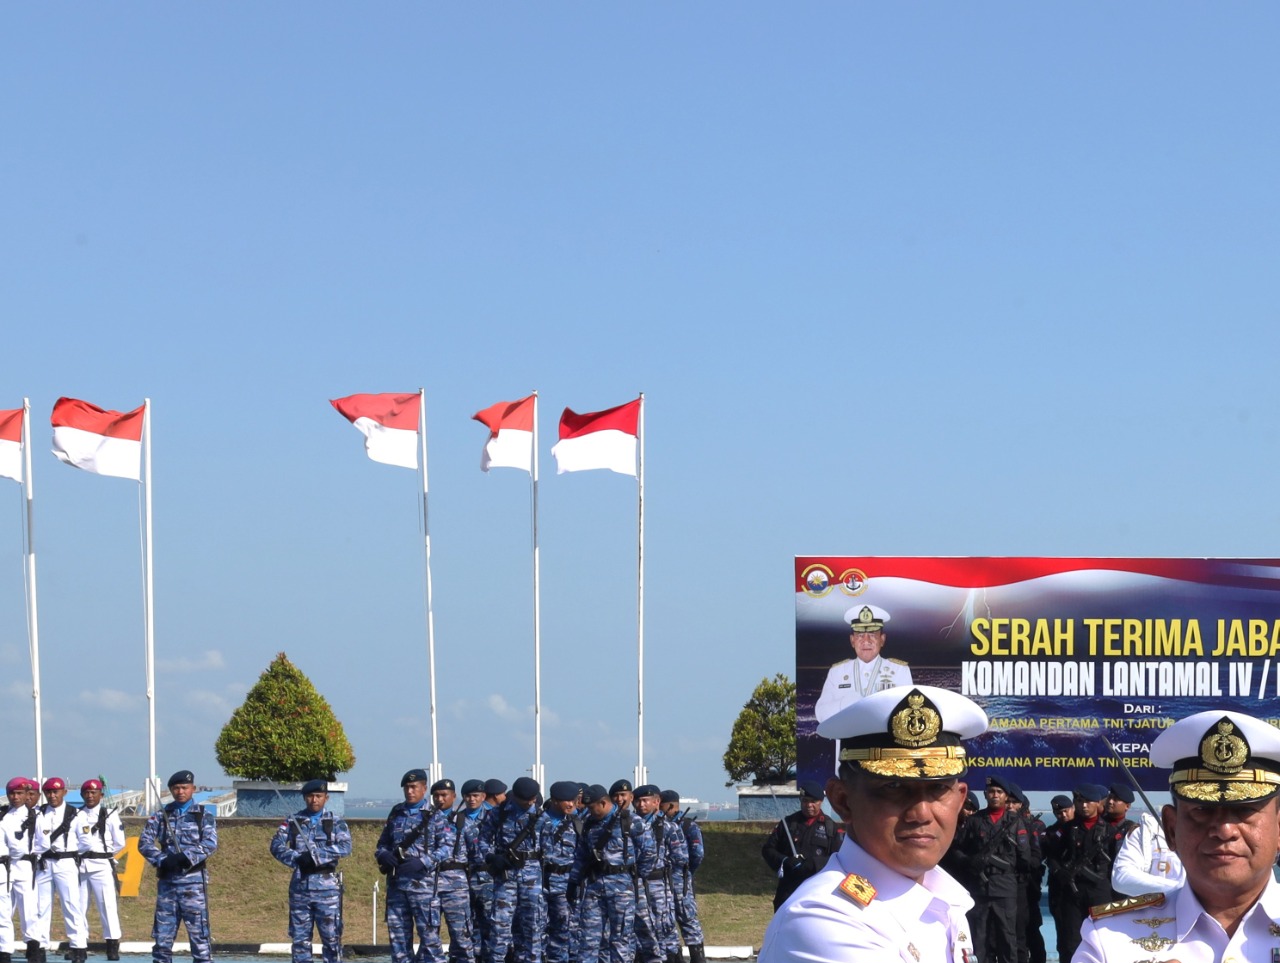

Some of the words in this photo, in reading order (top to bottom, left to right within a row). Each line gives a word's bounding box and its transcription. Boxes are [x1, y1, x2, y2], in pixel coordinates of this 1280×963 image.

[970, 618, 1074, 656] SERAH
[1083, 618, 1203, 656] TERIMA
[961, 661, 1095, 697] KOMANDAN
[1103, 661, 1222, 697] LANTAMAL
[1229, 662, 1253, 697] IV
[1258, 659, 1271, 700] /
[990, 718, 1036, 728] AMANA
[1040, 718, 1099, 729] PERTAMA
[1103, 718, 1124, 729] TNI
[1112, 743, 1153, 753] KEPA
[962, 757, 1032, 768] AKSAMANA
[1035, 757, 1095, 768] PERTAMA
[1098, 757, 1119, 768] TNI
